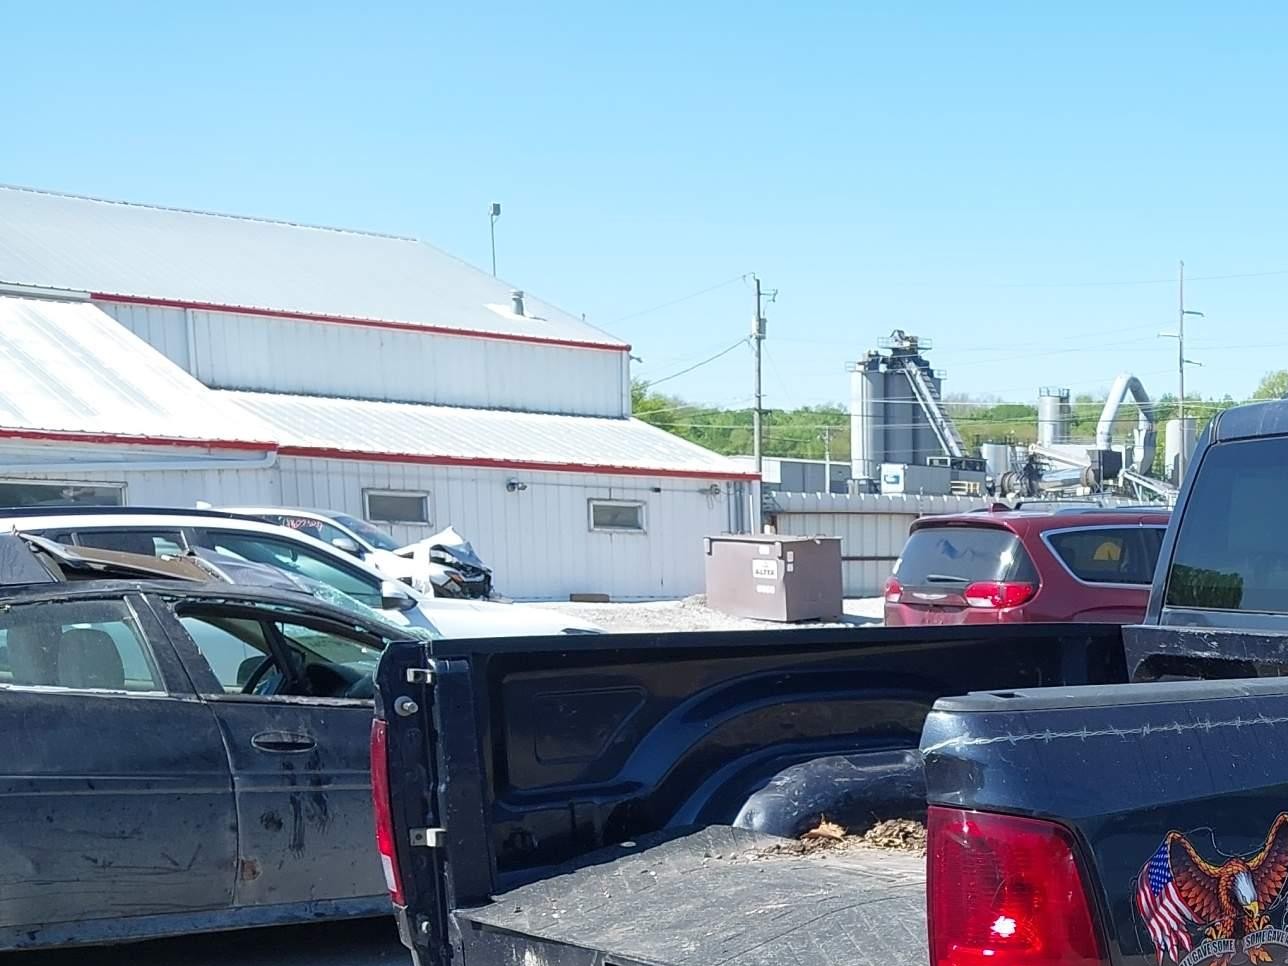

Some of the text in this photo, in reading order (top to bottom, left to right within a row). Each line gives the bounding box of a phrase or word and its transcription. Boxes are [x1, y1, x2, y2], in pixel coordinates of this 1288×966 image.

[1246, 931, 1267, 947] SOME
[1268, 930, 1285, 943] GAVE
[1191, 943, 1212, 963] GAVE
[1212, 940, 1234, 953] SOME
